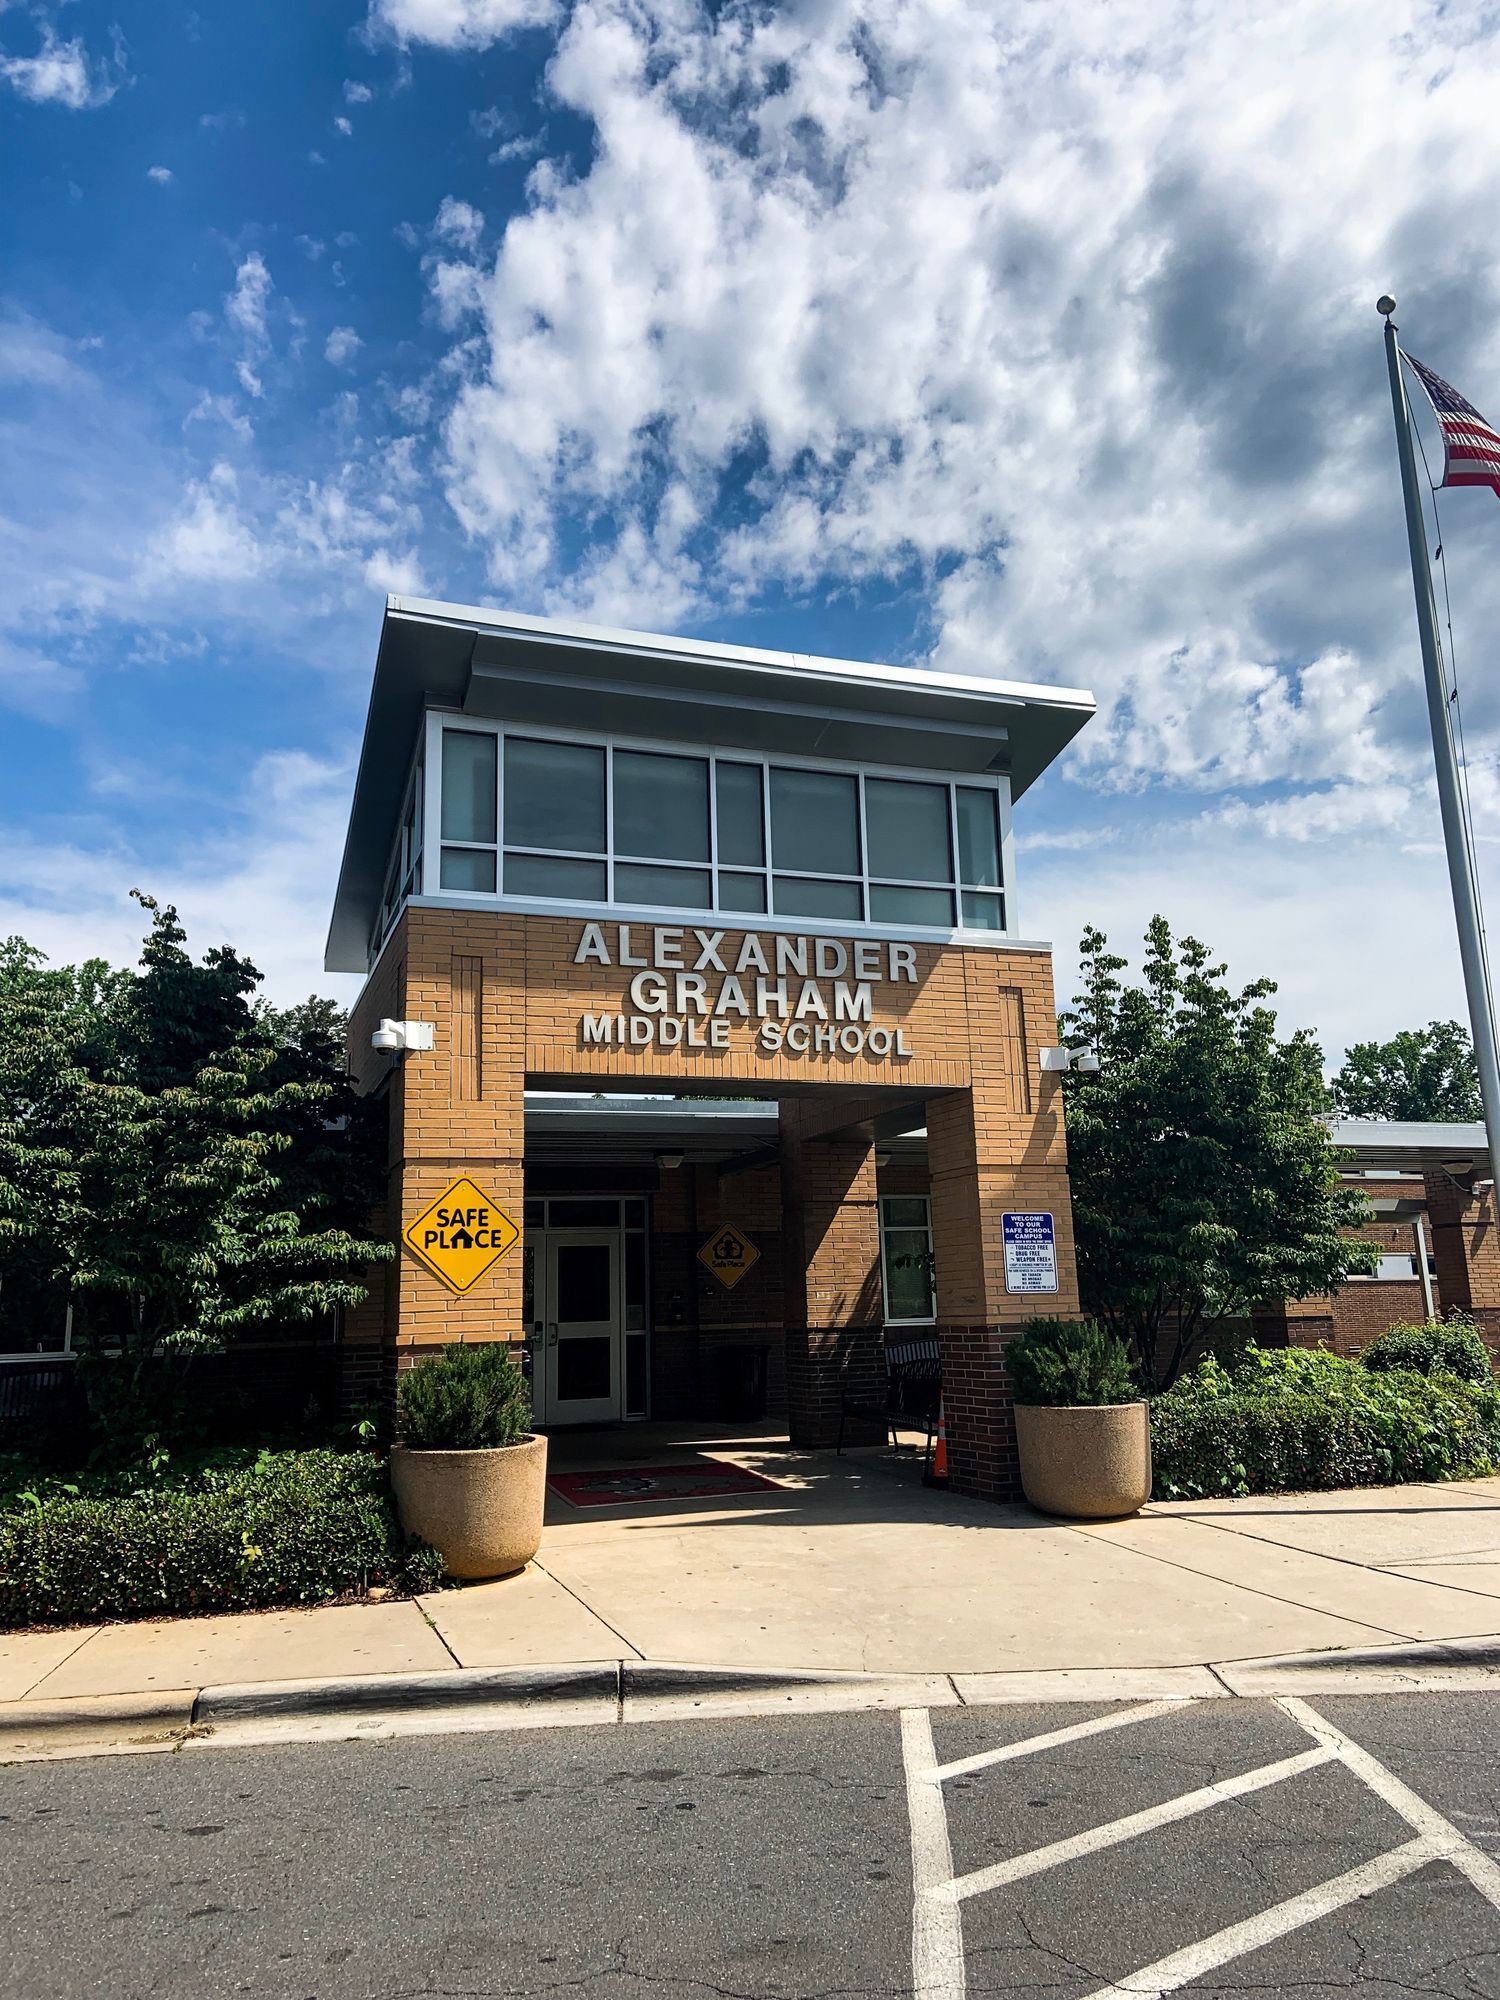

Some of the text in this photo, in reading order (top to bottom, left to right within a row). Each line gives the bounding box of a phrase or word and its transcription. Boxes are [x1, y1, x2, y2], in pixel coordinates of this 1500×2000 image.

[574, 923, 918, 983] ALEXANDER
[630, 971, 873, 1022] GRAHAM
[582, 1014, 914, 1057] MIDDLE SCHOOL
[436, 1208, 489, 1227] SAFE
